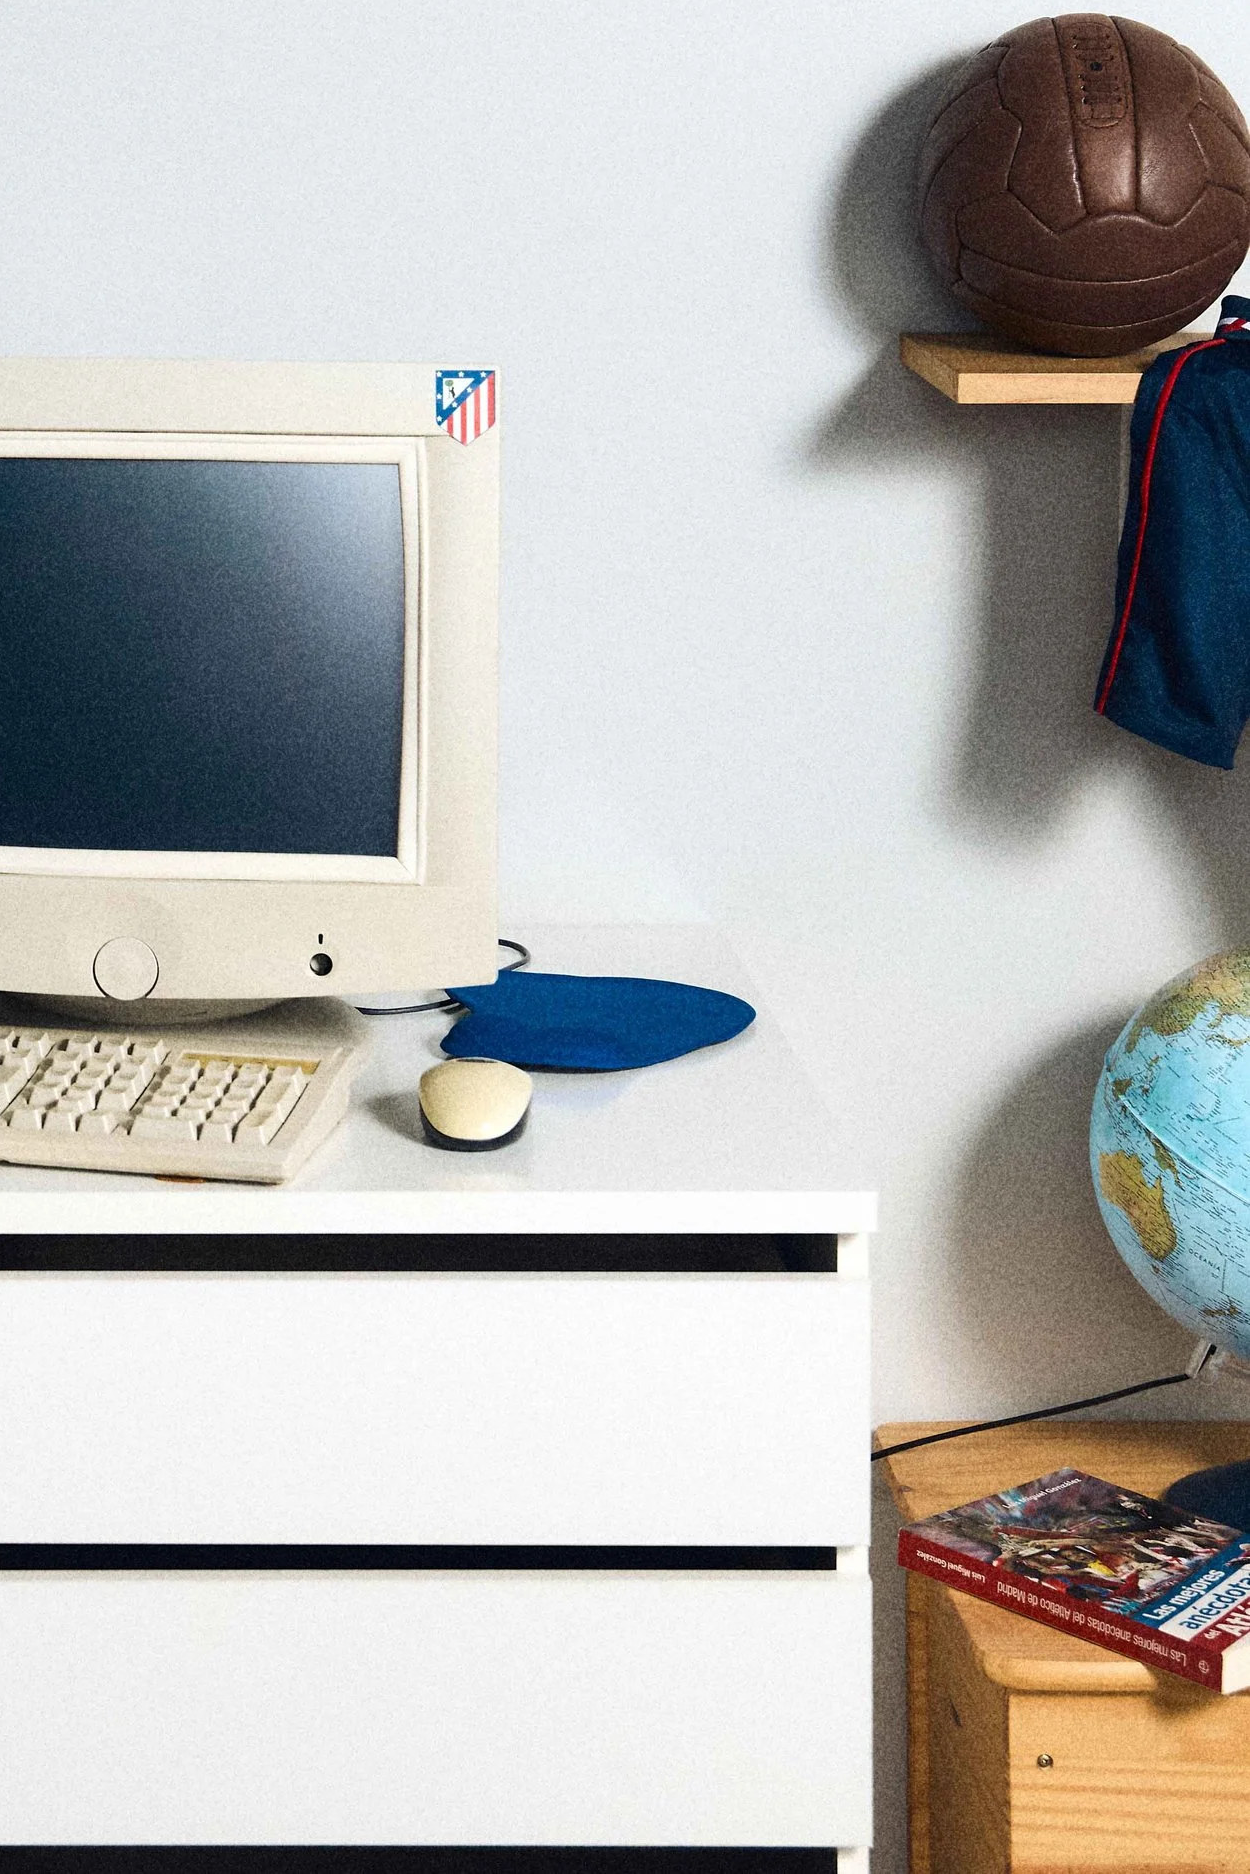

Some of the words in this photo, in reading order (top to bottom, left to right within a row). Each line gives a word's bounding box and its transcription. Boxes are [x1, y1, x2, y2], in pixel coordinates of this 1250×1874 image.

[916, 1549, 948, 1568] González
[947, 1561, 971, 1578] Miguel
[971, 1572, 986, 1584] Luis
[996, 1581, 1027, 1604] Madrid
[1027, 1592, 1039, 1605] de
[1142, 1604, 1177, 1621] Las
[1168, 1569, 1226, 1607] mejores
[1039, 1598, 1071, 1621] Atlético
[1072, 1609, 1086, 1625] del
[1087, 1615, 1132, 1643] anécdotas
[1133, 1634, 1169, 1657] mejores
[1169, 1650, 1187, 1667] Las
